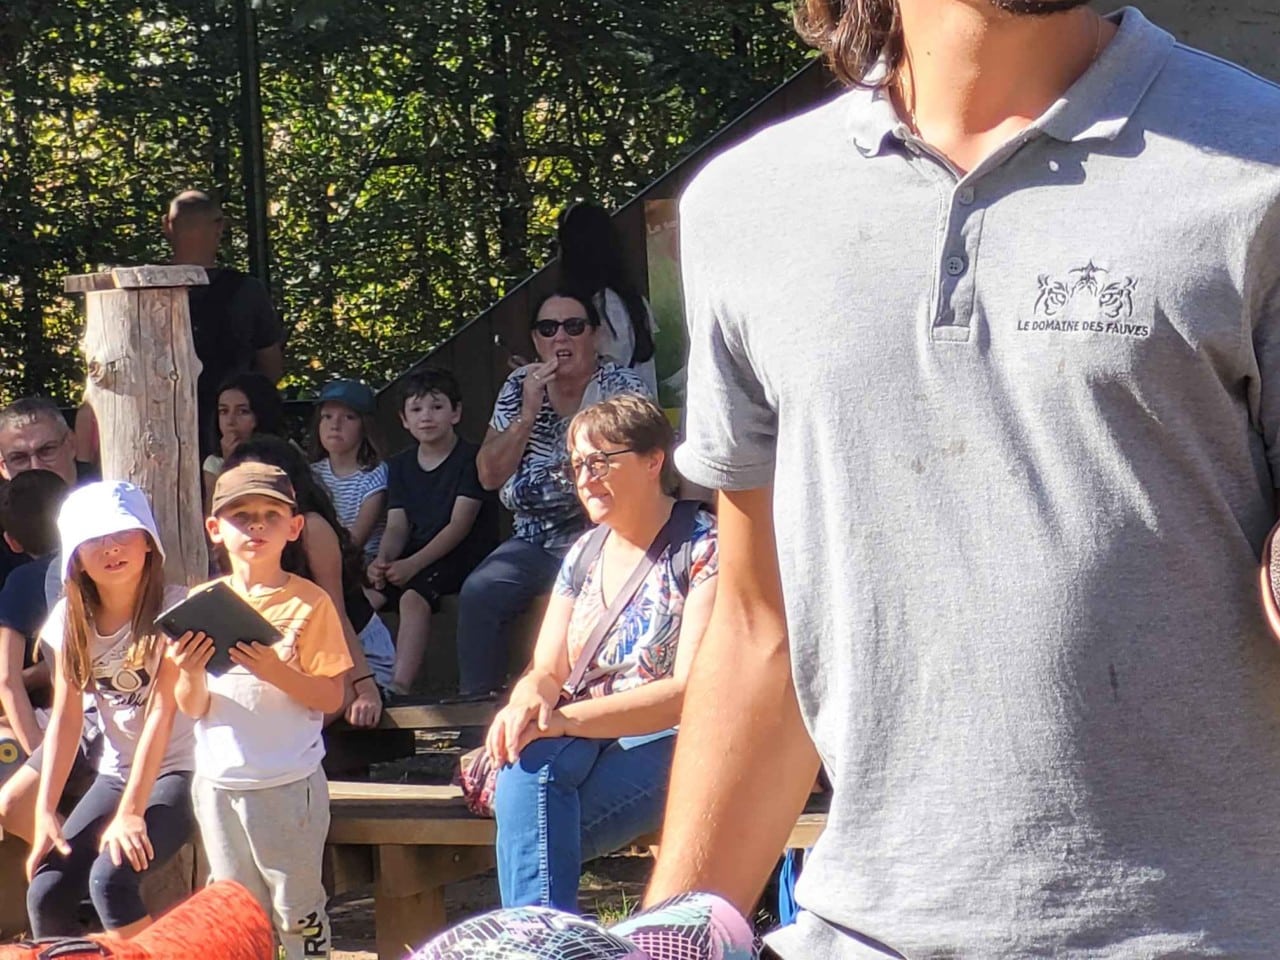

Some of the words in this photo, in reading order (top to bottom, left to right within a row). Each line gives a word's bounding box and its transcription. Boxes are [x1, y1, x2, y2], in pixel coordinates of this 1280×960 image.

[1017, 320, 1030, 331] LE
[1032, 320, 1080, 332] DOMAINE
[1082, 321, 1104, 332] DES
[1105, 322, 1149, 337] FAUVES
